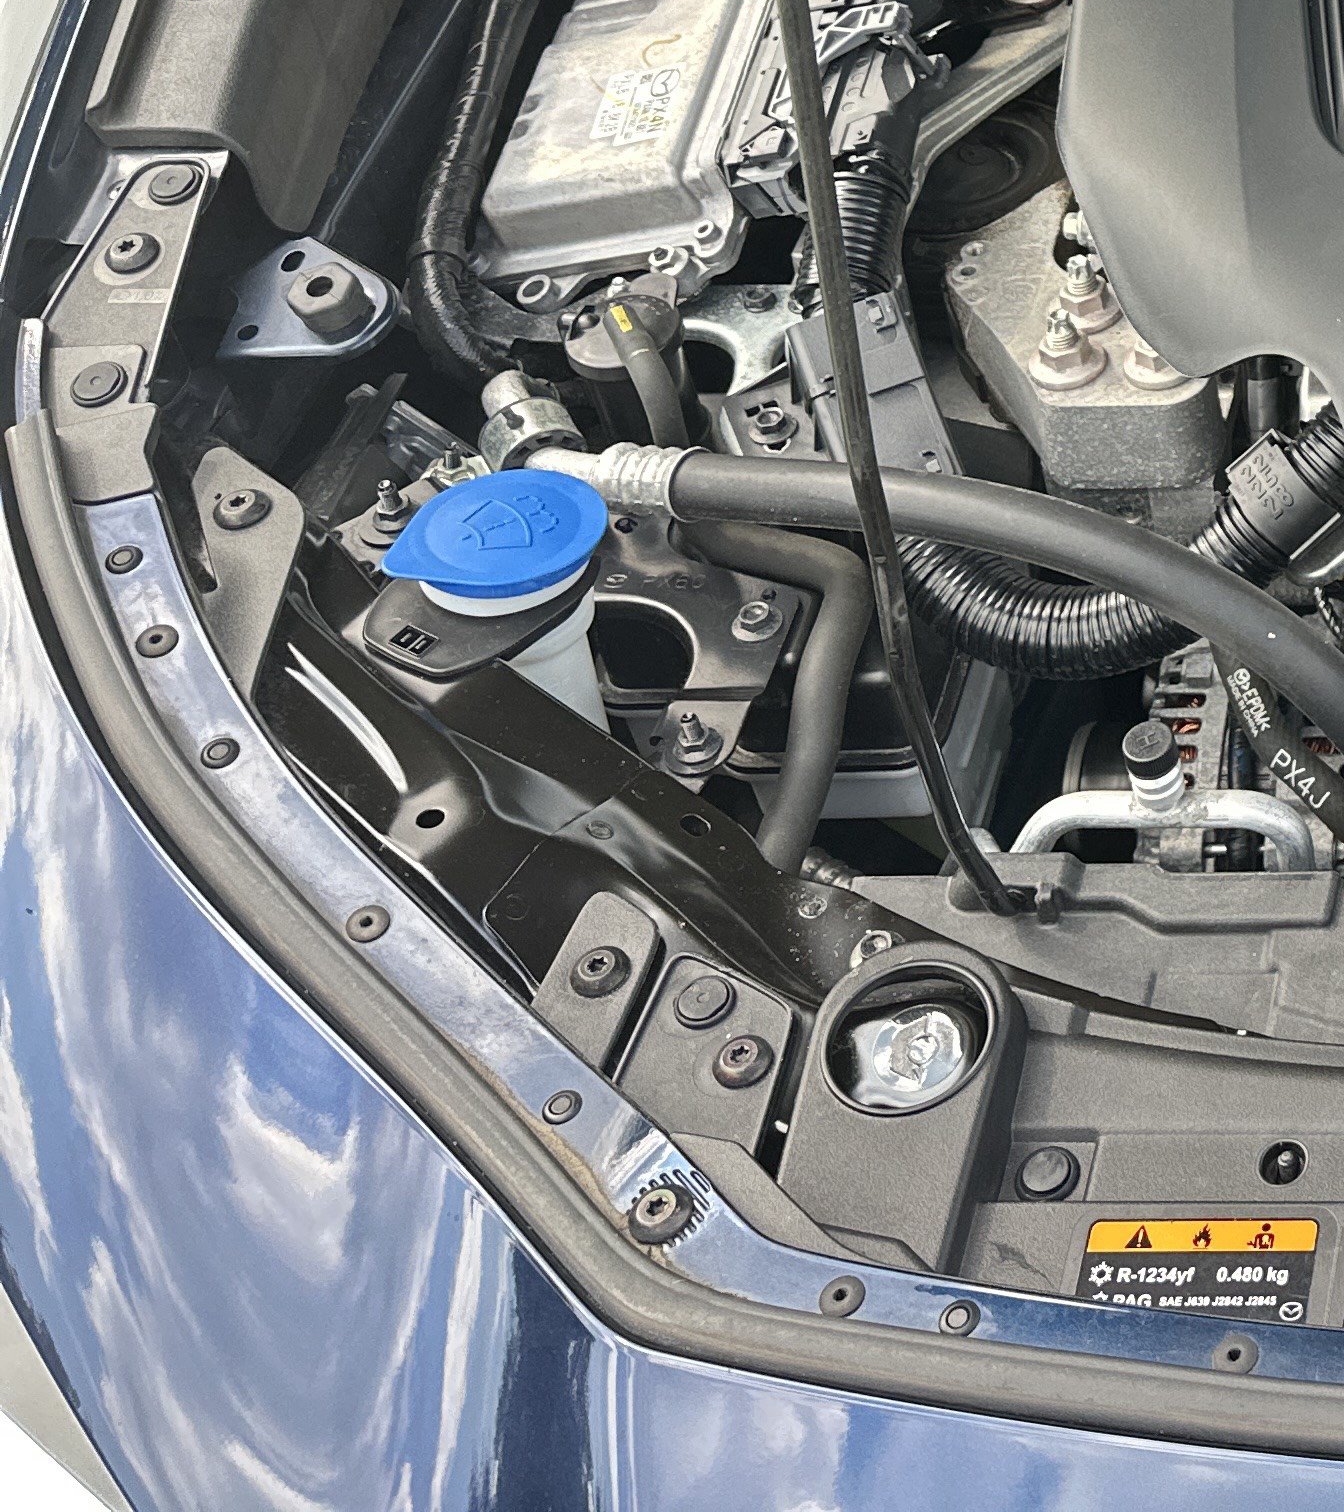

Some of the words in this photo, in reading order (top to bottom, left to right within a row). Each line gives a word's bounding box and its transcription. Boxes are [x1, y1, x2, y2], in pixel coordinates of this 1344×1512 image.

[1269, 748, 1332, 809] PX4J
[1116, 1266, 1196, 1287] R-1234yf
[1216, 1267, 1264, 1283] 0.480
[1266, 1266, 1290, 1287] kg
[1158, 1295, 1184, 1307] SAE
